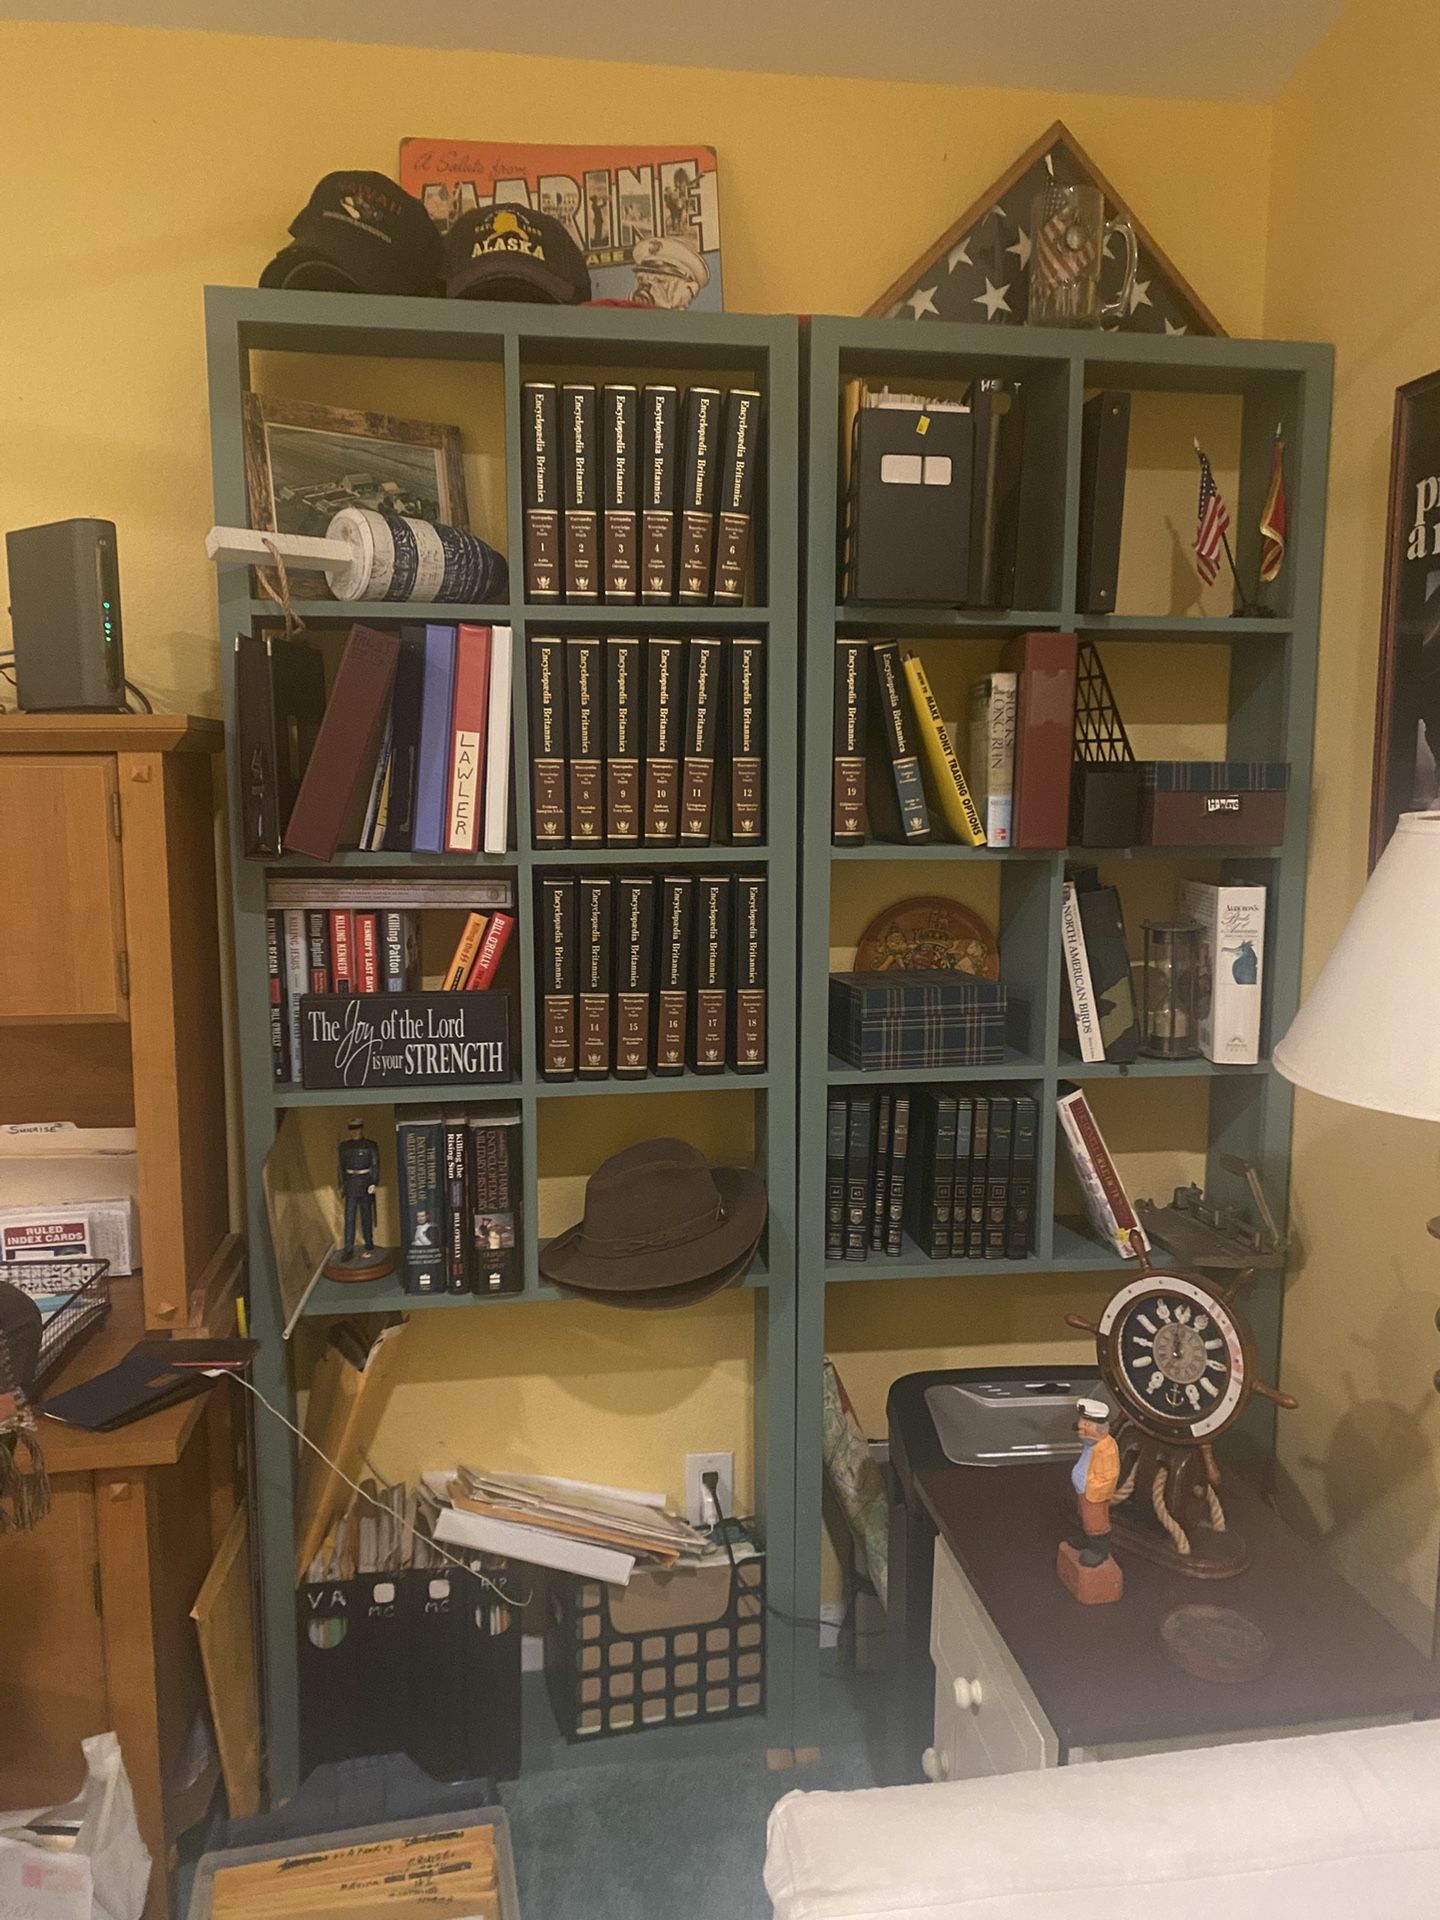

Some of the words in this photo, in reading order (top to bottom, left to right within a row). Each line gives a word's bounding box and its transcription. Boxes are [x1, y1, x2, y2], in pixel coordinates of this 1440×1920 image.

[471, 237, 545, 261] ALASKA
[537, 456, 545, 502] Britannica
[576, 458, 584, 503] Britannica
[617, 458, 625, 503] Britannica
[654, 458, 663, 504] Britannica
[696, 460, 706, 505] Britannica
[733, 461, 744, 506] Britannica
[544, 708, 552, 752] Britannica
[582, 709, 590, 753] Britannica
[619, 708, 627, 752] Britannica
[660, 708, 668, 751] Britannica
[696, 708, 706, 751] Britannica
[848, 708, 856, 750] Britannica
[893, 710, 905, 752] Britannica
[455, 733, 475, 835] LAWLER
[925, 695, 941, 721] MAKE
[935, 725, 954, 758] MONEY
[949, 758, 967, 798] TRADING
[962, 799, 983, 836] OPTIONS
[335, 915, 347, 942] KILLING
[387, 913, 401, 942] Killing
[489, 917, 505, 935] BILL
[1064, 904, 1077, 945] NORTH
[337, 943, 348, 975] KENNEDY
[389, 944, 401, 974] Patton
[555, 947, 563, 988] Britannica
[592, 946, 600, 987] Britannica
[631, 945, 639, 987] Britannica
[672, 944, 680, 984] Britannica
[1069, 946, 1085, 1001] AMERICAN
[1078, 1002, 1092, 1034] BIRDS
[307, 1010, 341, 1042] The
[334, 1000, 383, 1086] Joy
[381, 1008, 399, 1040] of
[399, 1010, 424, 1040] the
[427, 1008, 465, 1039] Lord
[372, 1051, 382, 1070] is
[381, 1055, 405, 1076] your
[404, 1041, 504, 1075] STRENGTH
[447, 1133, 455, 1161] Rising
[456, 1164, 464, 1178] the
[7, 1235, 43, 1245] INDEX
[44, 1232, 83, 1242] CARDS
[25, 1225, 64, 1236] RULED
